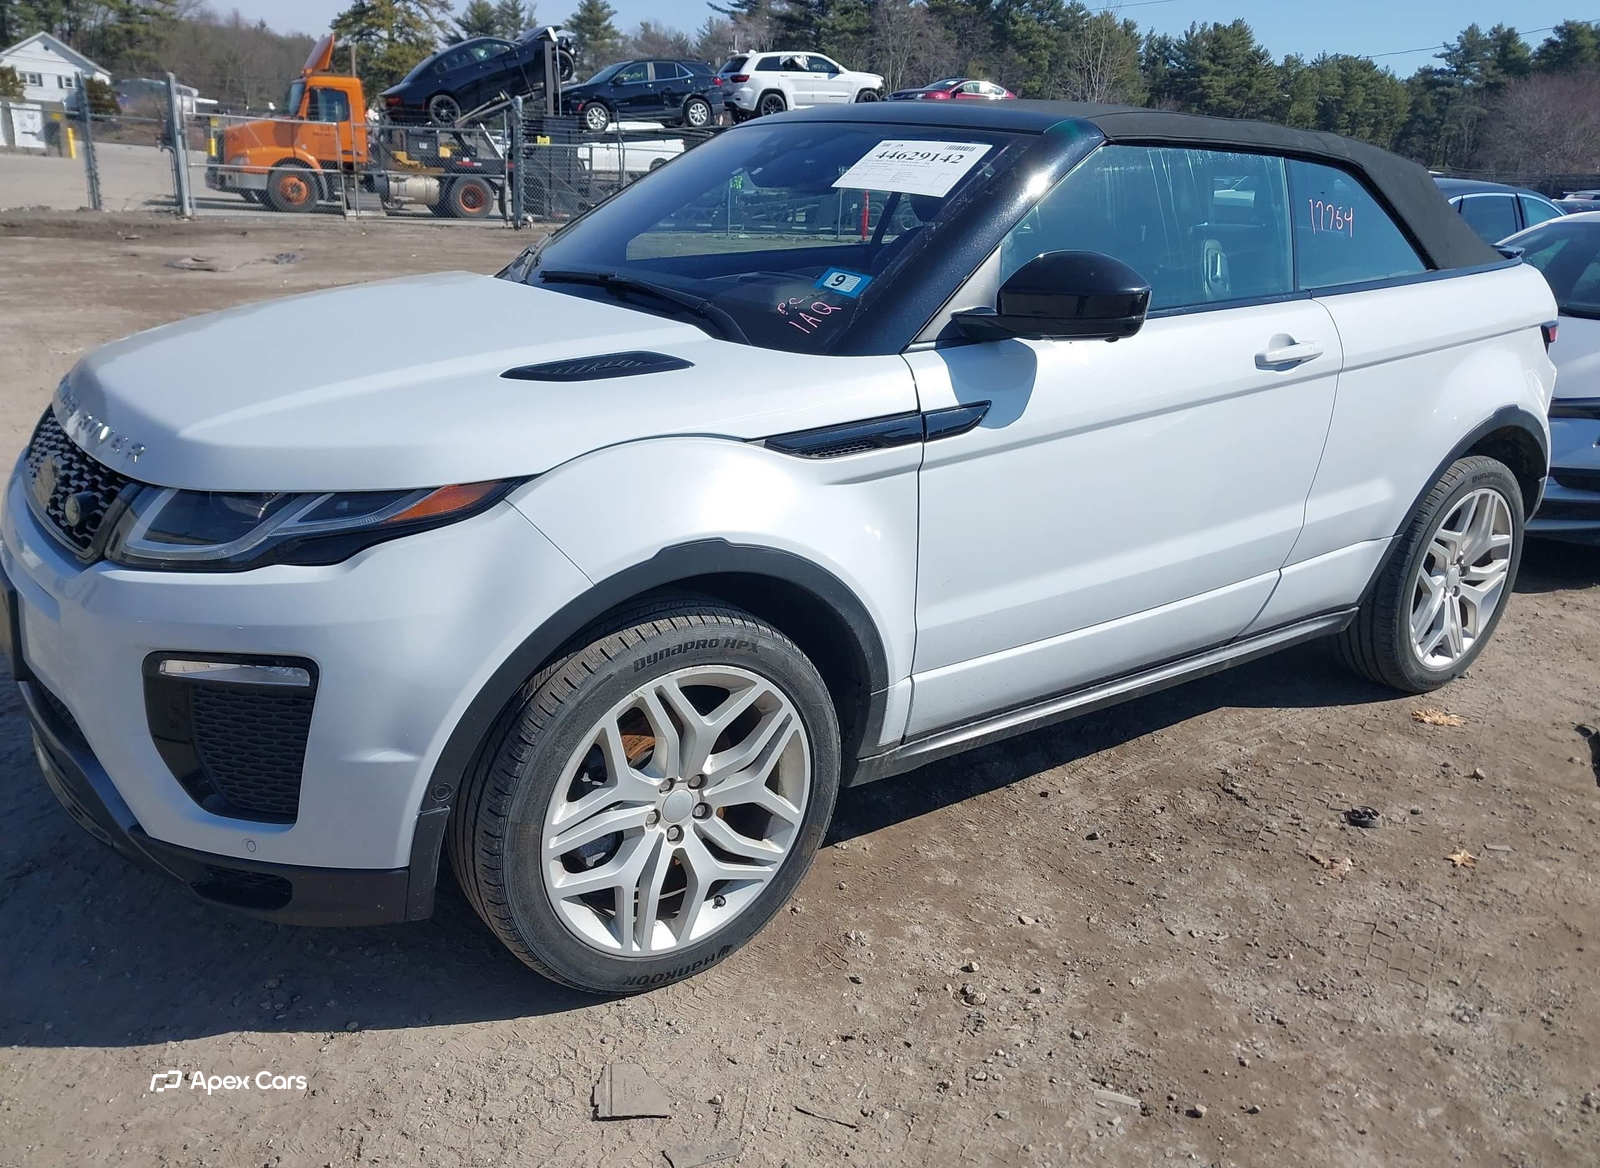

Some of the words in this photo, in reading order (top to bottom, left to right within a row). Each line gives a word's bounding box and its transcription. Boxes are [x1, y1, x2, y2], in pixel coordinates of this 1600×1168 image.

[875, 150, 965, 164] 44629142
[830, 274, 847, 287] 9
[723, 638, 761, 654] HPX
